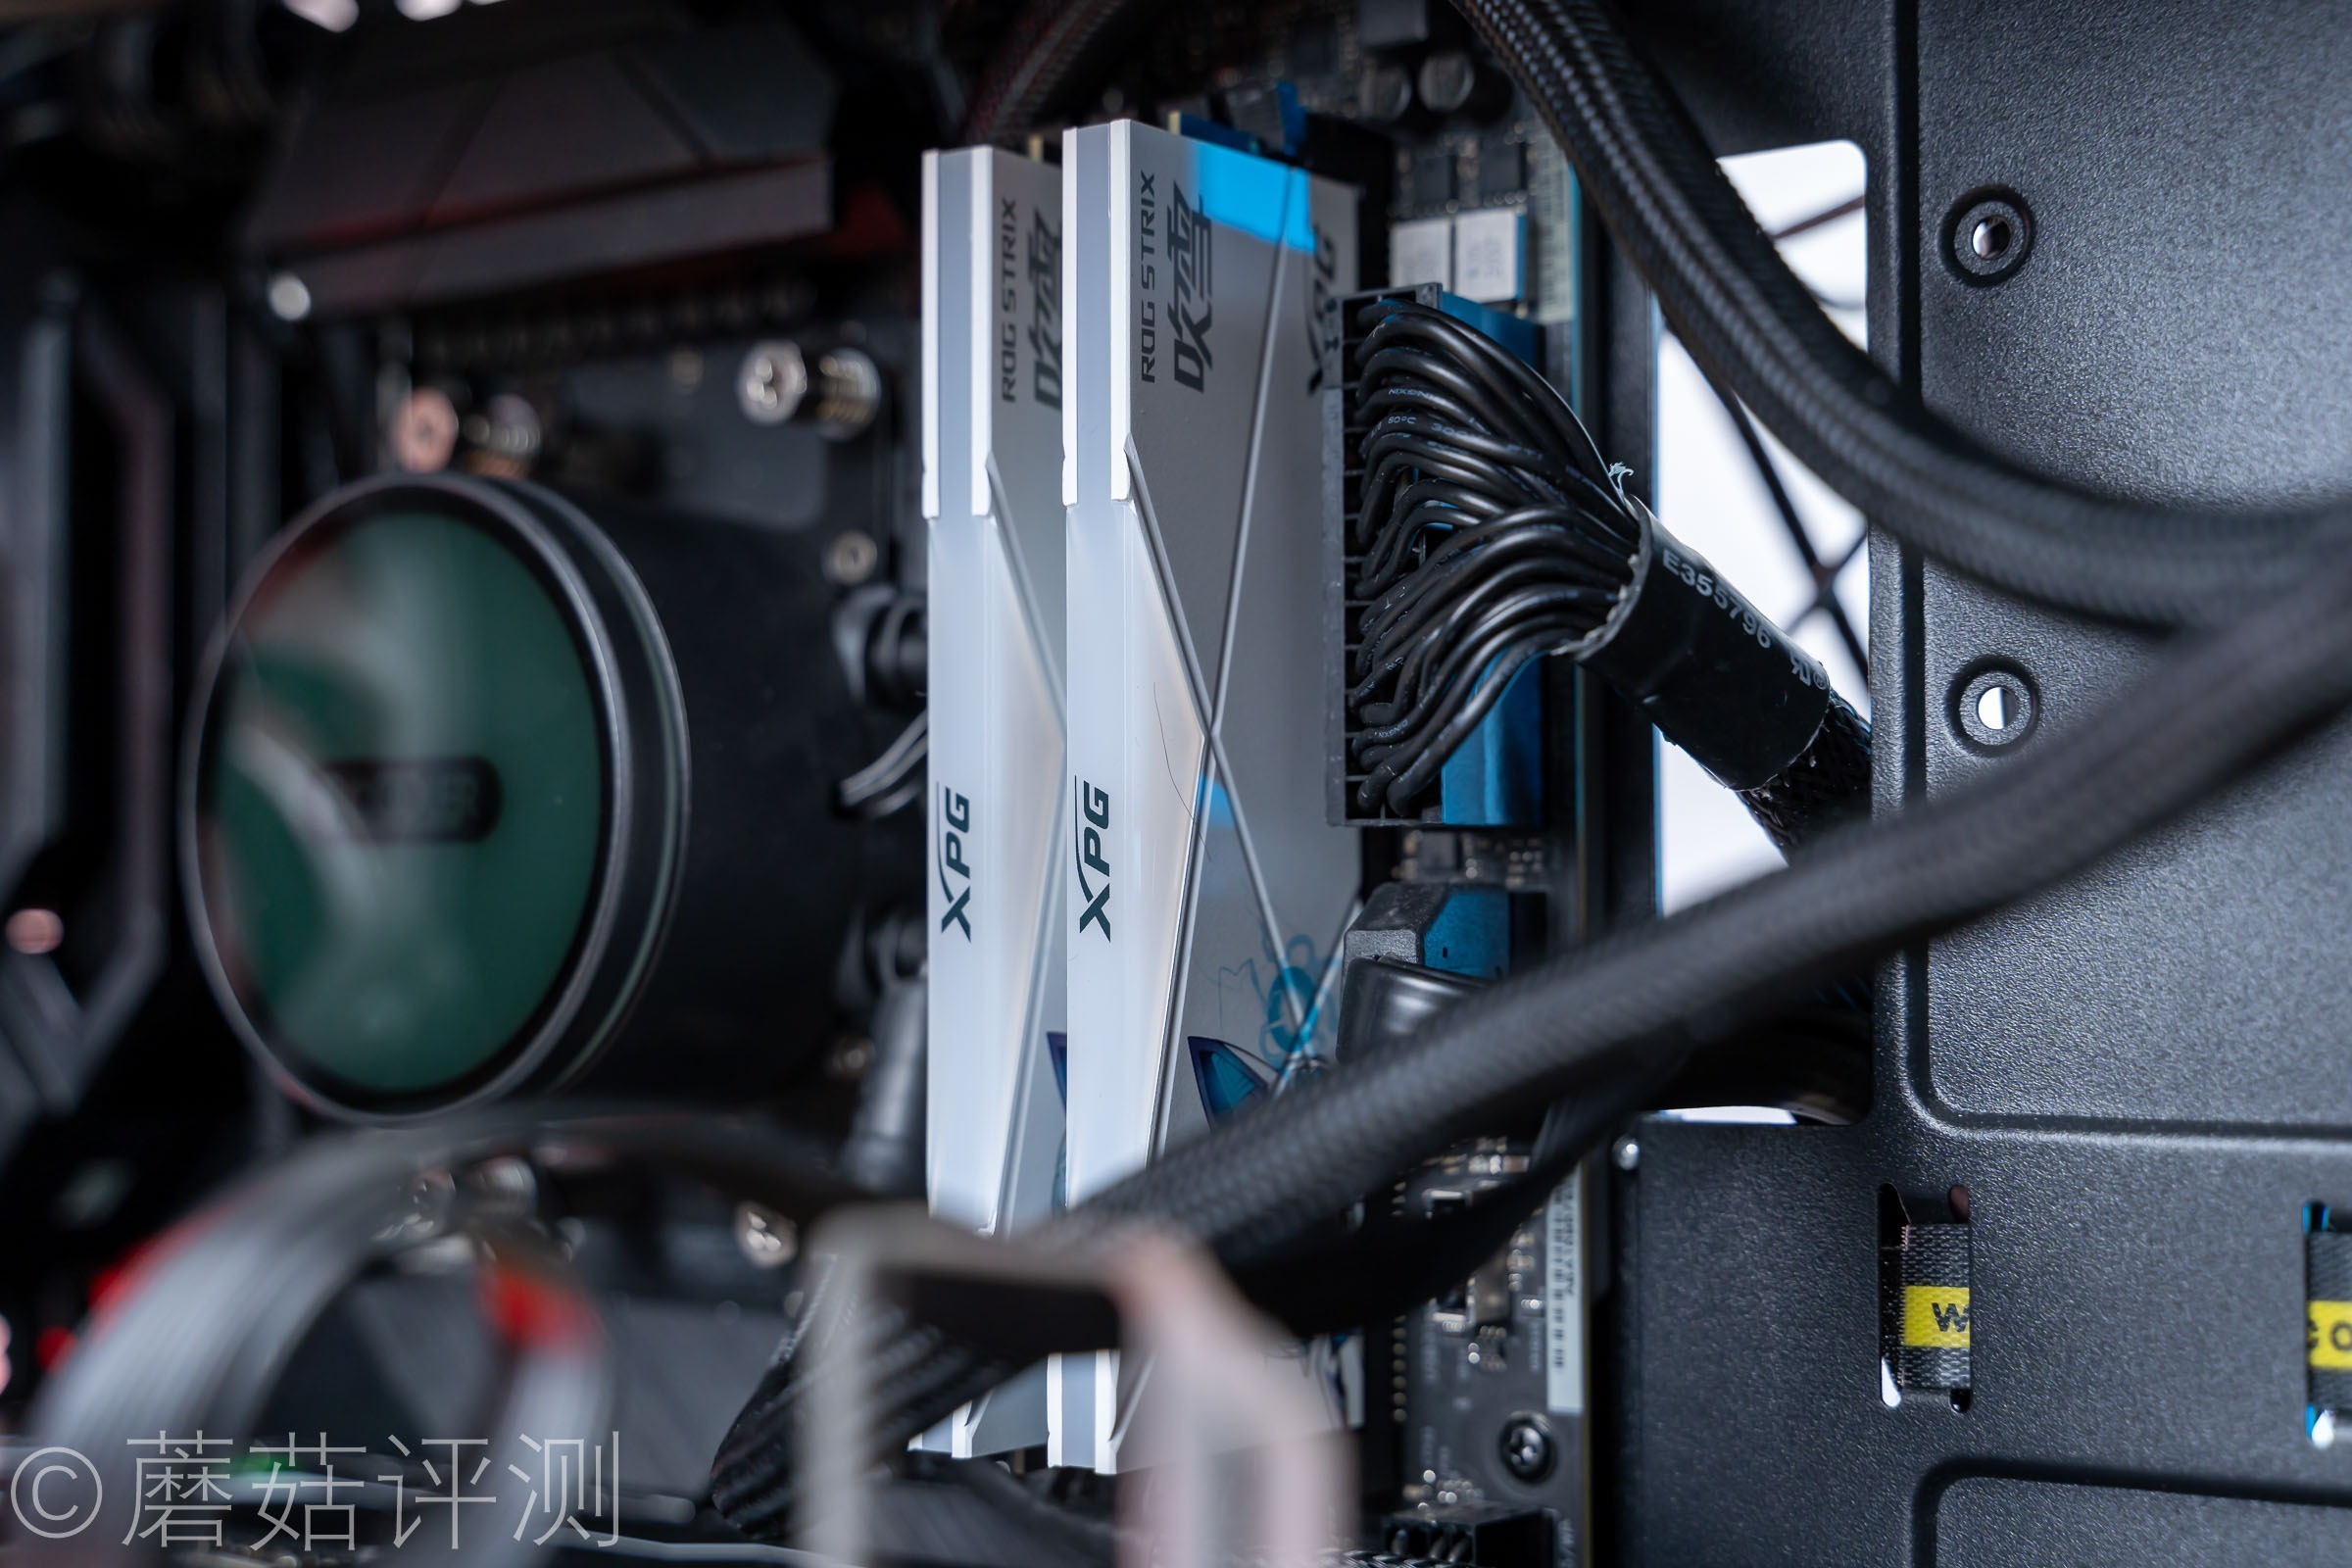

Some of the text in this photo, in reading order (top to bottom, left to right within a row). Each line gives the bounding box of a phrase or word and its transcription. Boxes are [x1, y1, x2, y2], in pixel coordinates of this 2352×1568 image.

[1002, 197, 1017, 404] ROG STRIX
[1141, 170, 1156, 384] ROG STRIX
[1662, 548, 1772, 649] E355796
[937, 781, 971, 944] XPG
[1075, 775, 1111, 944] XPG
